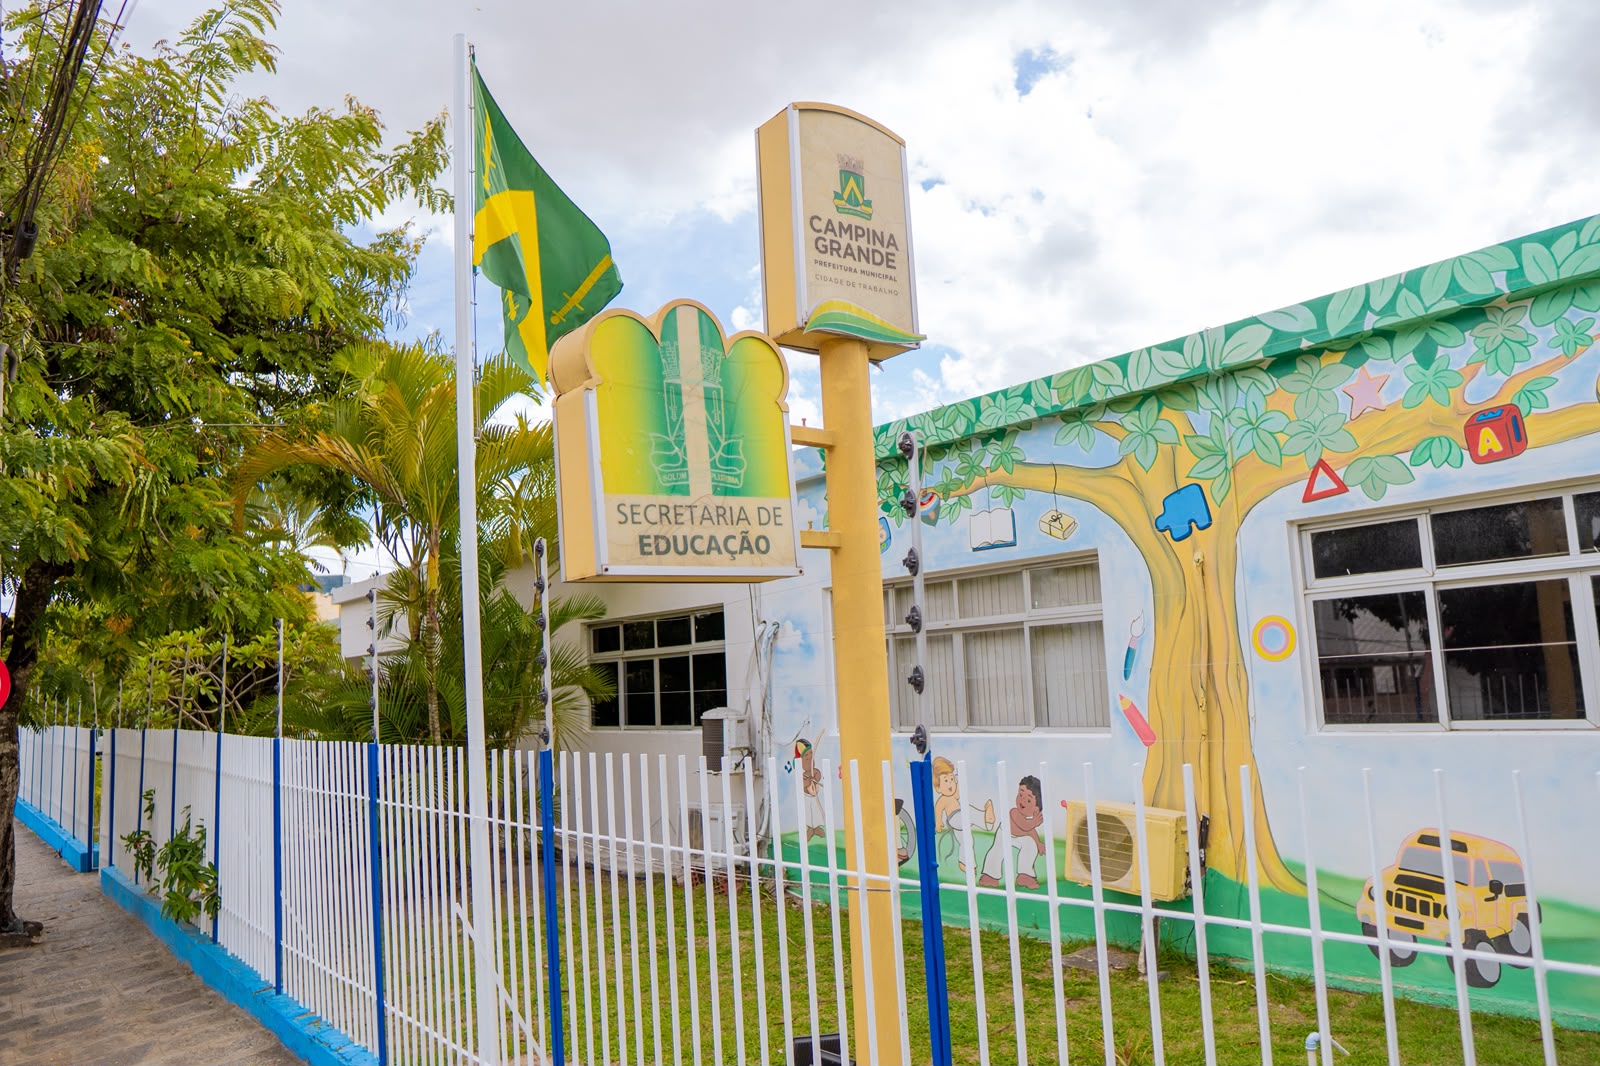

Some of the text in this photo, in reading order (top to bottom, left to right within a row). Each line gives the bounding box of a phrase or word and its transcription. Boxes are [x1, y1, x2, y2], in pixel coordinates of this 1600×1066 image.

[809, 214, 899, 252] CAMPINA
[814, 236, 897, 270] GRANDE
[814, 259, 898, 282] PREFEITURA MUNICIPAL
[815, 273, 899, 296] CIDADE DE TRABALHO
[1478, 427, 1503, 457] A
[616, 503, 783, 526] SECRETARIA DE
[638, 530, 771, 561] EDUCAÇÃO
